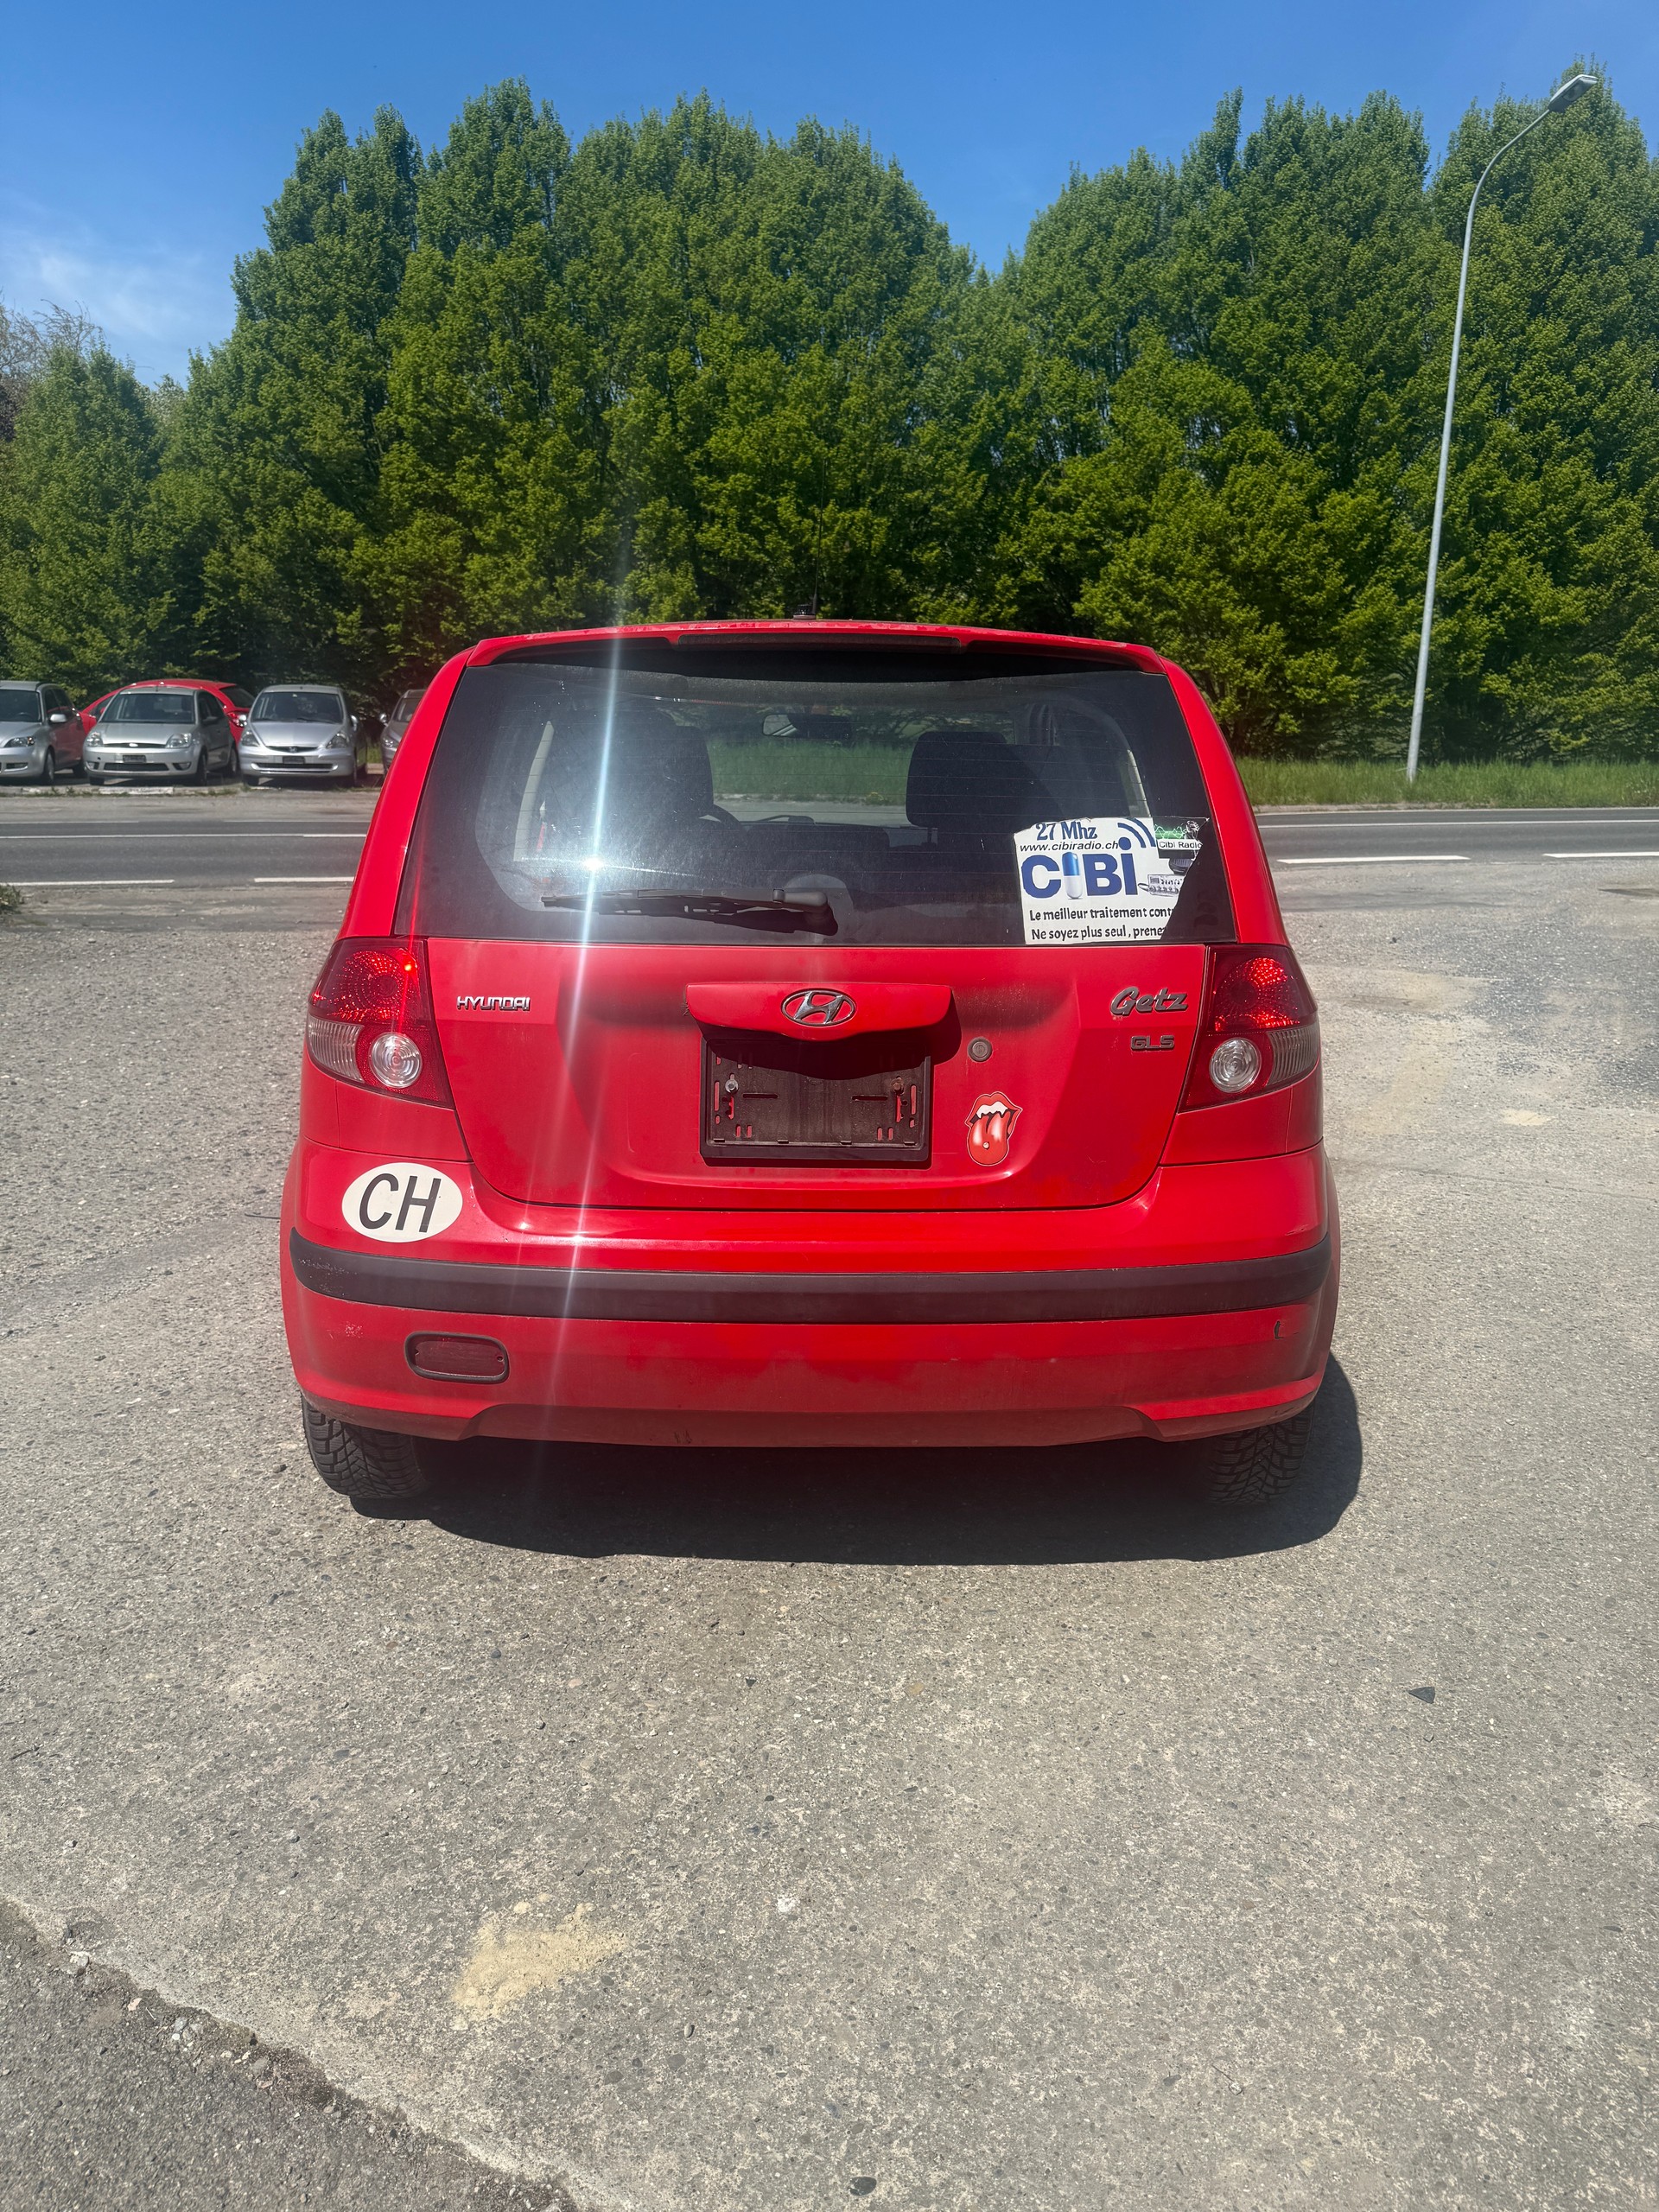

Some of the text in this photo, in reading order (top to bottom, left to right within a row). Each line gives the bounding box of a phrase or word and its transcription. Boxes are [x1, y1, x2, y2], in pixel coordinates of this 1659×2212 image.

[1035, 821, 1098, 841] 27 Mhz
[1020, 841, 1119, 852] www.cibiradio.ch
[1029, 906, 1174, 921] Le meilleur traitement cont
[1031, 929, 1047, 940] Ne
[1049, 929, 1079, 941] soyez
[1080, 925, 1103, 940] plus
[1133, 926, 1165, 939] prene
[457, 996, 531, 1011] HYUNDAI
[1110, 986, 1188, 1016] Getz
[1130, 1035, 1175, 1051] GLS
[359, 1173, 442, 1233] CH
